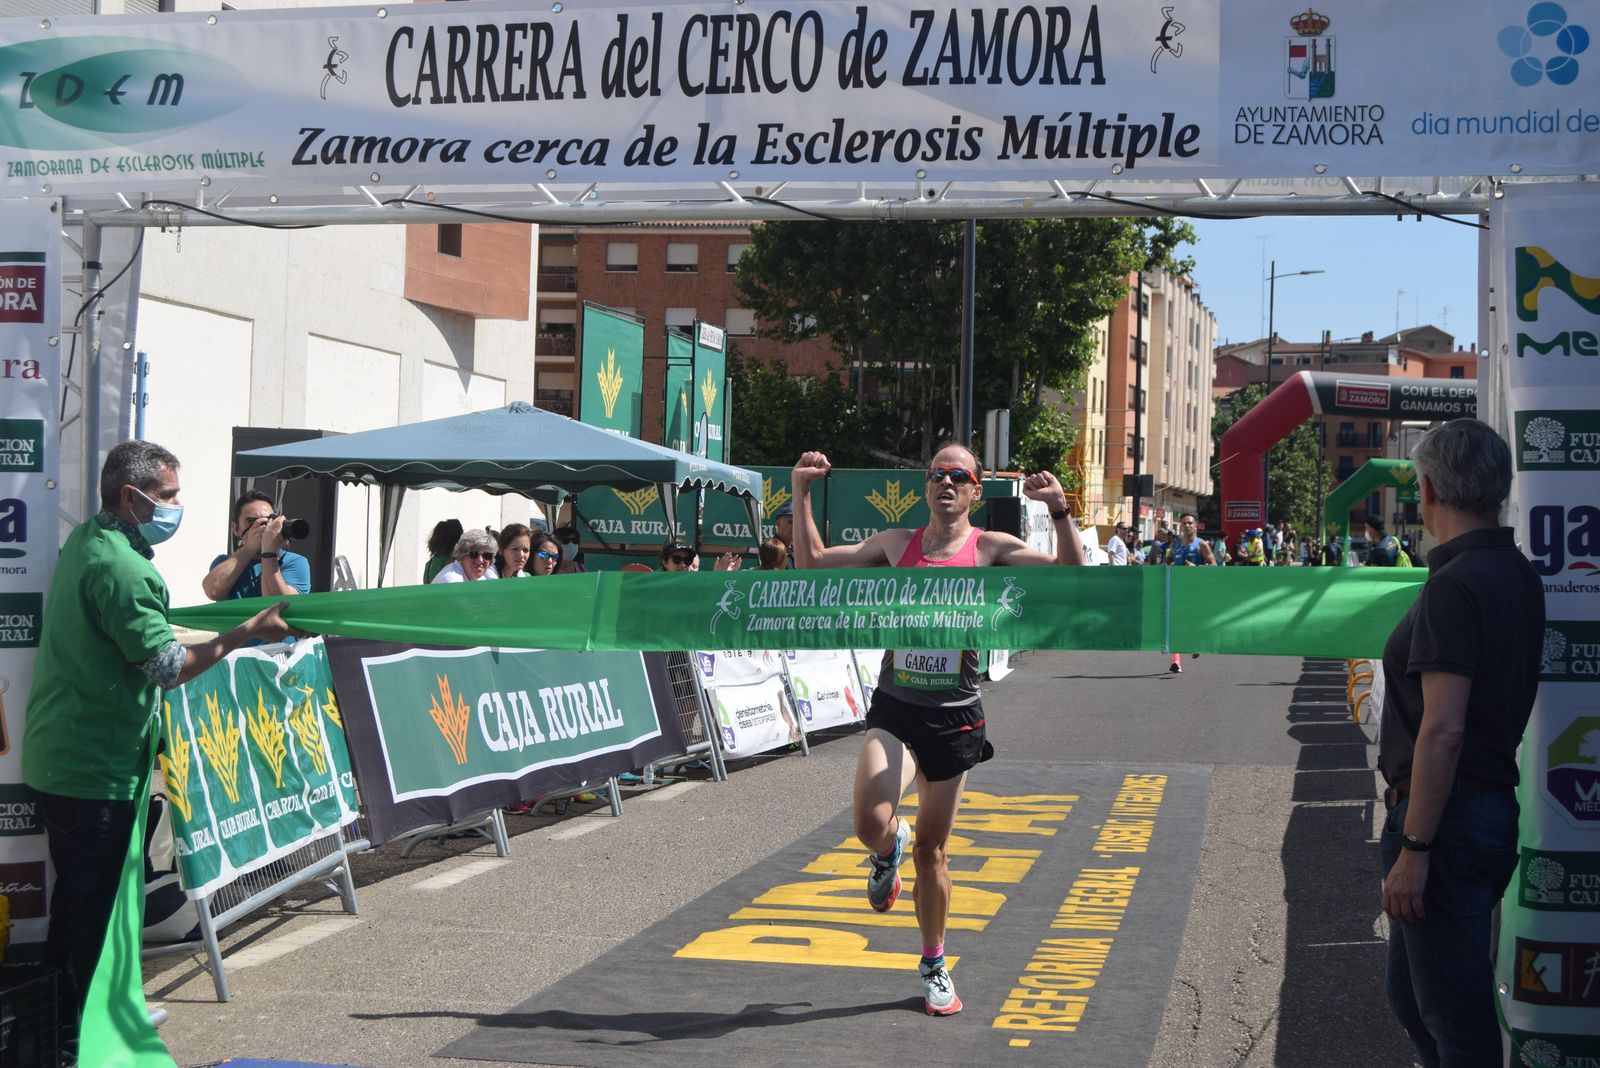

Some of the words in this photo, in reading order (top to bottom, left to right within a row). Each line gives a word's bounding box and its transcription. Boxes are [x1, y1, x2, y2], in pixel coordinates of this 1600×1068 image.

[386, 19, 587, 108] CARRERA
[601, 12, 664, 100] del
[678, 9, 824, 98] CERCO
[837, 6, 889, 90] de
[902, 4, 1106, 87] ZAMORA
[1235, 104, 1385, 123] AYUNTAMIENTO
[1411, 112, 1450, 136] dia
[1456, 109, 1560, 135] mundial
[1566, 107, 1600, 133] de
[291, 126, 472, 166] Zamora
[484, 138, 610, 167] cerca
[623, 123, 679, 167] de
[698, 122, 738, 165] la
[750, 114, 984, 165] Esclerosis
[997, 111, 1201, 169] Múltiple
[1234, 123, 1265, 145] DE
[1271, 123, 1384, 146] ZAMORA
[8, 158, 84, 178] ZAMORANA
[90, 156, 110, 174] DE
[116, 153, 195, 173] ESCLEROSIS
[202, 148, 265, 170] MÚLTIPLE
[17, 277, 37, 289] DE
[1348, 395, 1387, 405] ZAMORA
[1400, 385, 1428, 397] CON
[1431, 387, 1446, 398] EL
[1400, 400, 1461, 413] GANAMOS
[588, 518, 626, 535] CAJA
[713, 522, 753, 539] CAJA
[749, 580, 816, 609] CARRERA
[819, 578, 842, 608] del
[846, 578, 897, 607] CERCO
[899, 577, 917, 606] de
[920, 577, 986, 607] ZAMORA
[1542, 580, 1600, 594] anaderos
[747, 613, 795, 632] Zamora
[798, 614, 831, 631] cerca
[834, 612, 850, 630] de
[853, 611, 866, 629] la
[868, 610, 929, 630] Esclerosis
[932, 608, 984, 633] Múltiple
[905, 653, 948, 673] GARGAR
[477, 688, 546, 753] CAJA
[538, 677, 625, 741] RURAL
[1091, 818, 1156, 853] DISEÑO
[1049, 866, 1141, 931] INTEGRAL
[991, 937, 1115, 1033] REFORMA
